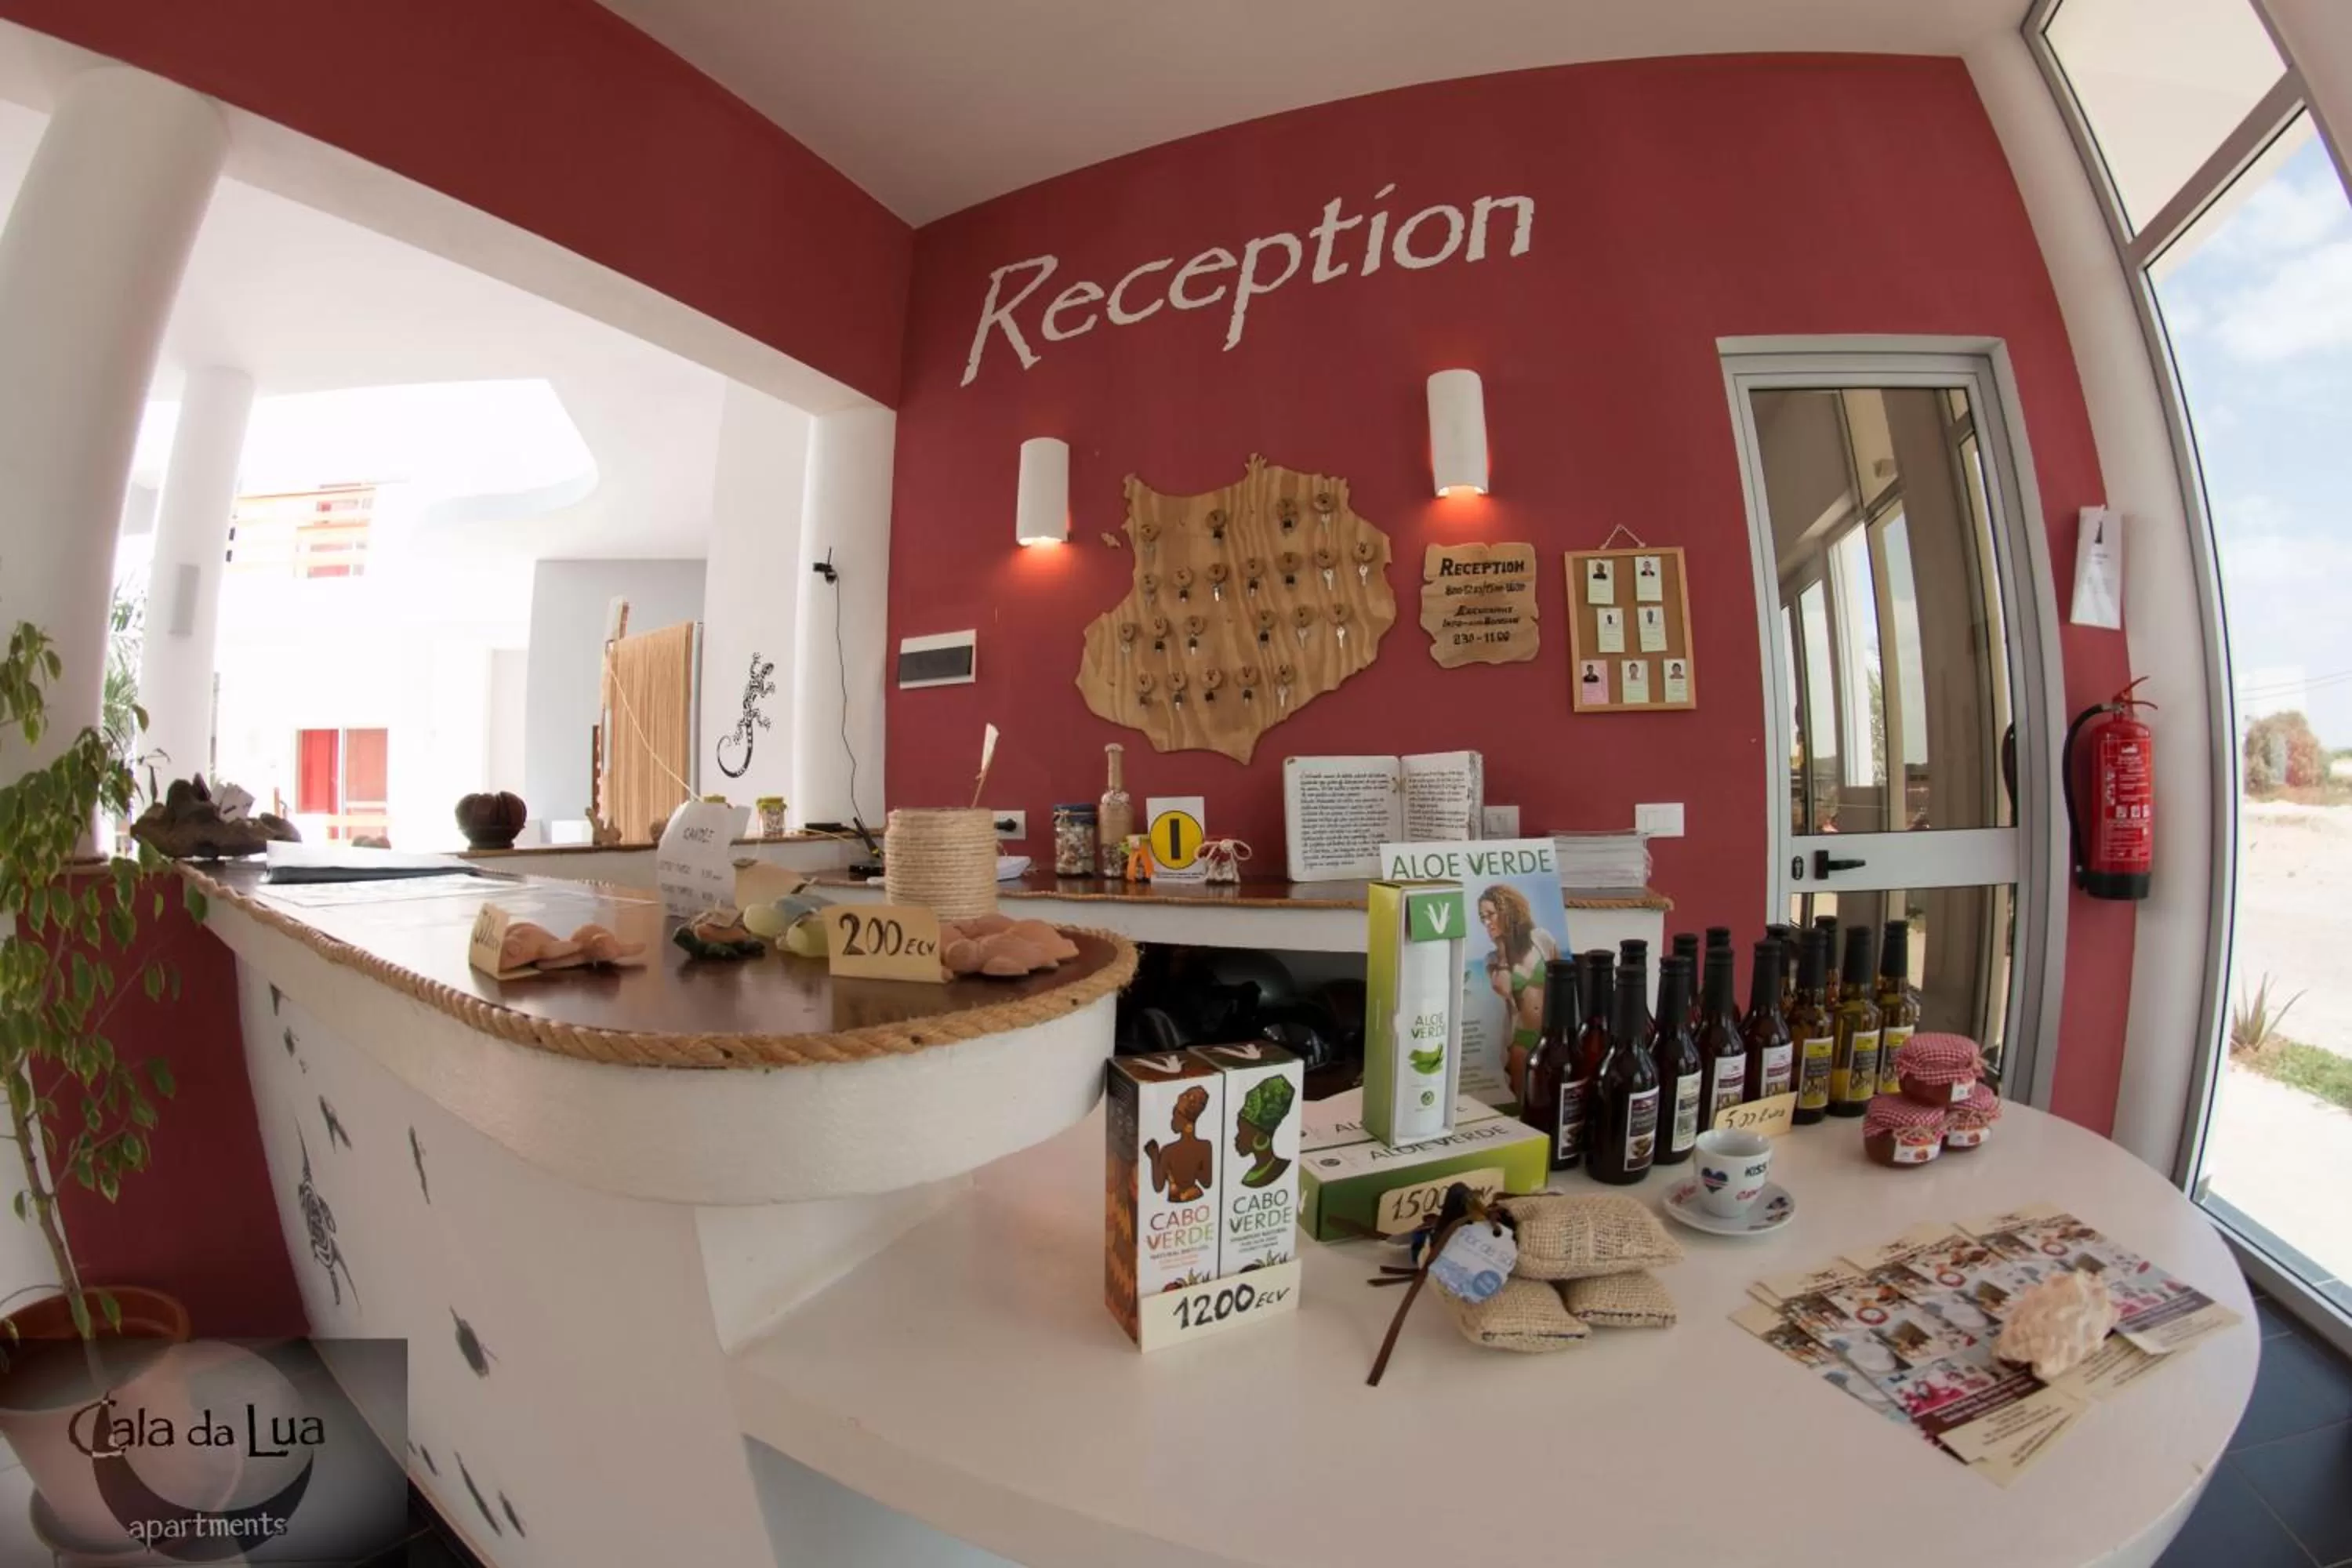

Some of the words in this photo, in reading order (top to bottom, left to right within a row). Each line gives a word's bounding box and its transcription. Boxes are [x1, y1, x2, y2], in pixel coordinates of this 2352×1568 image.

[960, 183, 1534, 387] Reception
[1392, 853, 1461, 878] ALOE
[1466, 849, 1552, 876] VERDE
[839, 913, 903, 956] 200
[1370, 1142, 1433, 1161] ALOE
[1432, 1124, 1509, 1147] VERDE
[1232, 1189, 1288, 1214] CABO
[1150, 1205, 1210, 1231] CABO
[1229, 1207, 1293, 1233] VERDE
[1147, 1222, 1214, 1250] VERDE
[1173, 1283, 1255, 1330] 1200
